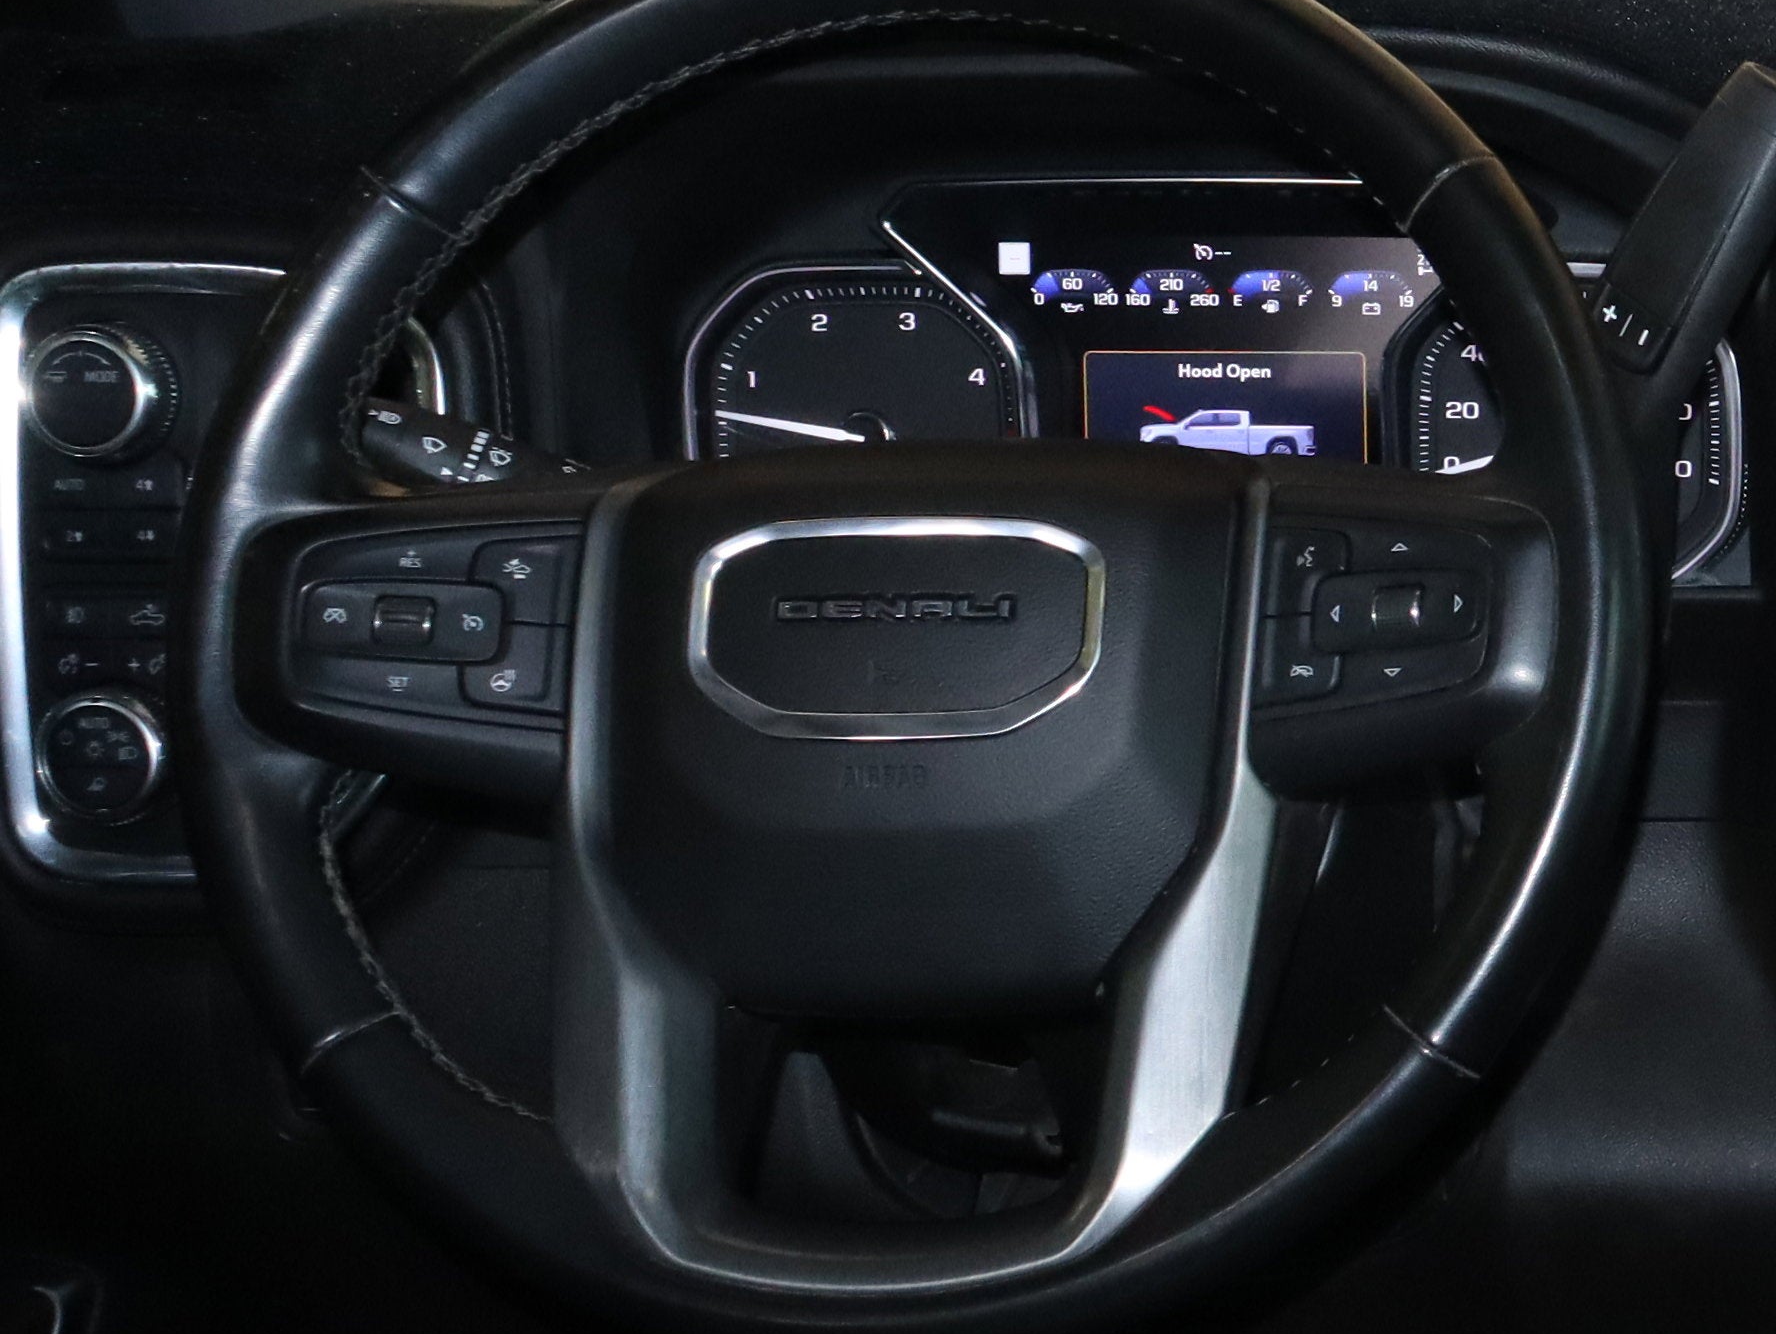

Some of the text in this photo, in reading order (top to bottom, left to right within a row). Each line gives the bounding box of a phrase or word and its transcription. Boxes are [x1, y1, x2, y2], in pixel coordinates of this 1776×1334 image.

[1062, 278, 1082, 291] 60
[1160, 278, 1183, 292] 210
[1261, 279, 1280, 292] 1/2
[1363, 279, 1378, 292] 14
[1034, 294, 1044, 306] 0
[1093, 294, 1118, 306] 120
[1126, 294, 1150, 306] 160
[1190, 294, 1219, 307] 260
[1233, 295, 1242, 307] E
[1299, 295, 1308, 307] F
[1331, 295, 1342, 307] 9
[1399, 296, 1414, 307] 19
[811, 314, 828, 332] 2
[899, 312, 916, 331] 3
[747, 370, 757, 388] 1
[967, 368, 986, 386] 4
[1178, 364, 1271, 382] Hood Open
[1445, 402, 1479, 419] 20
[399, 556, 422, 568] RES
[773, 592, 1017, 620] DENALI
